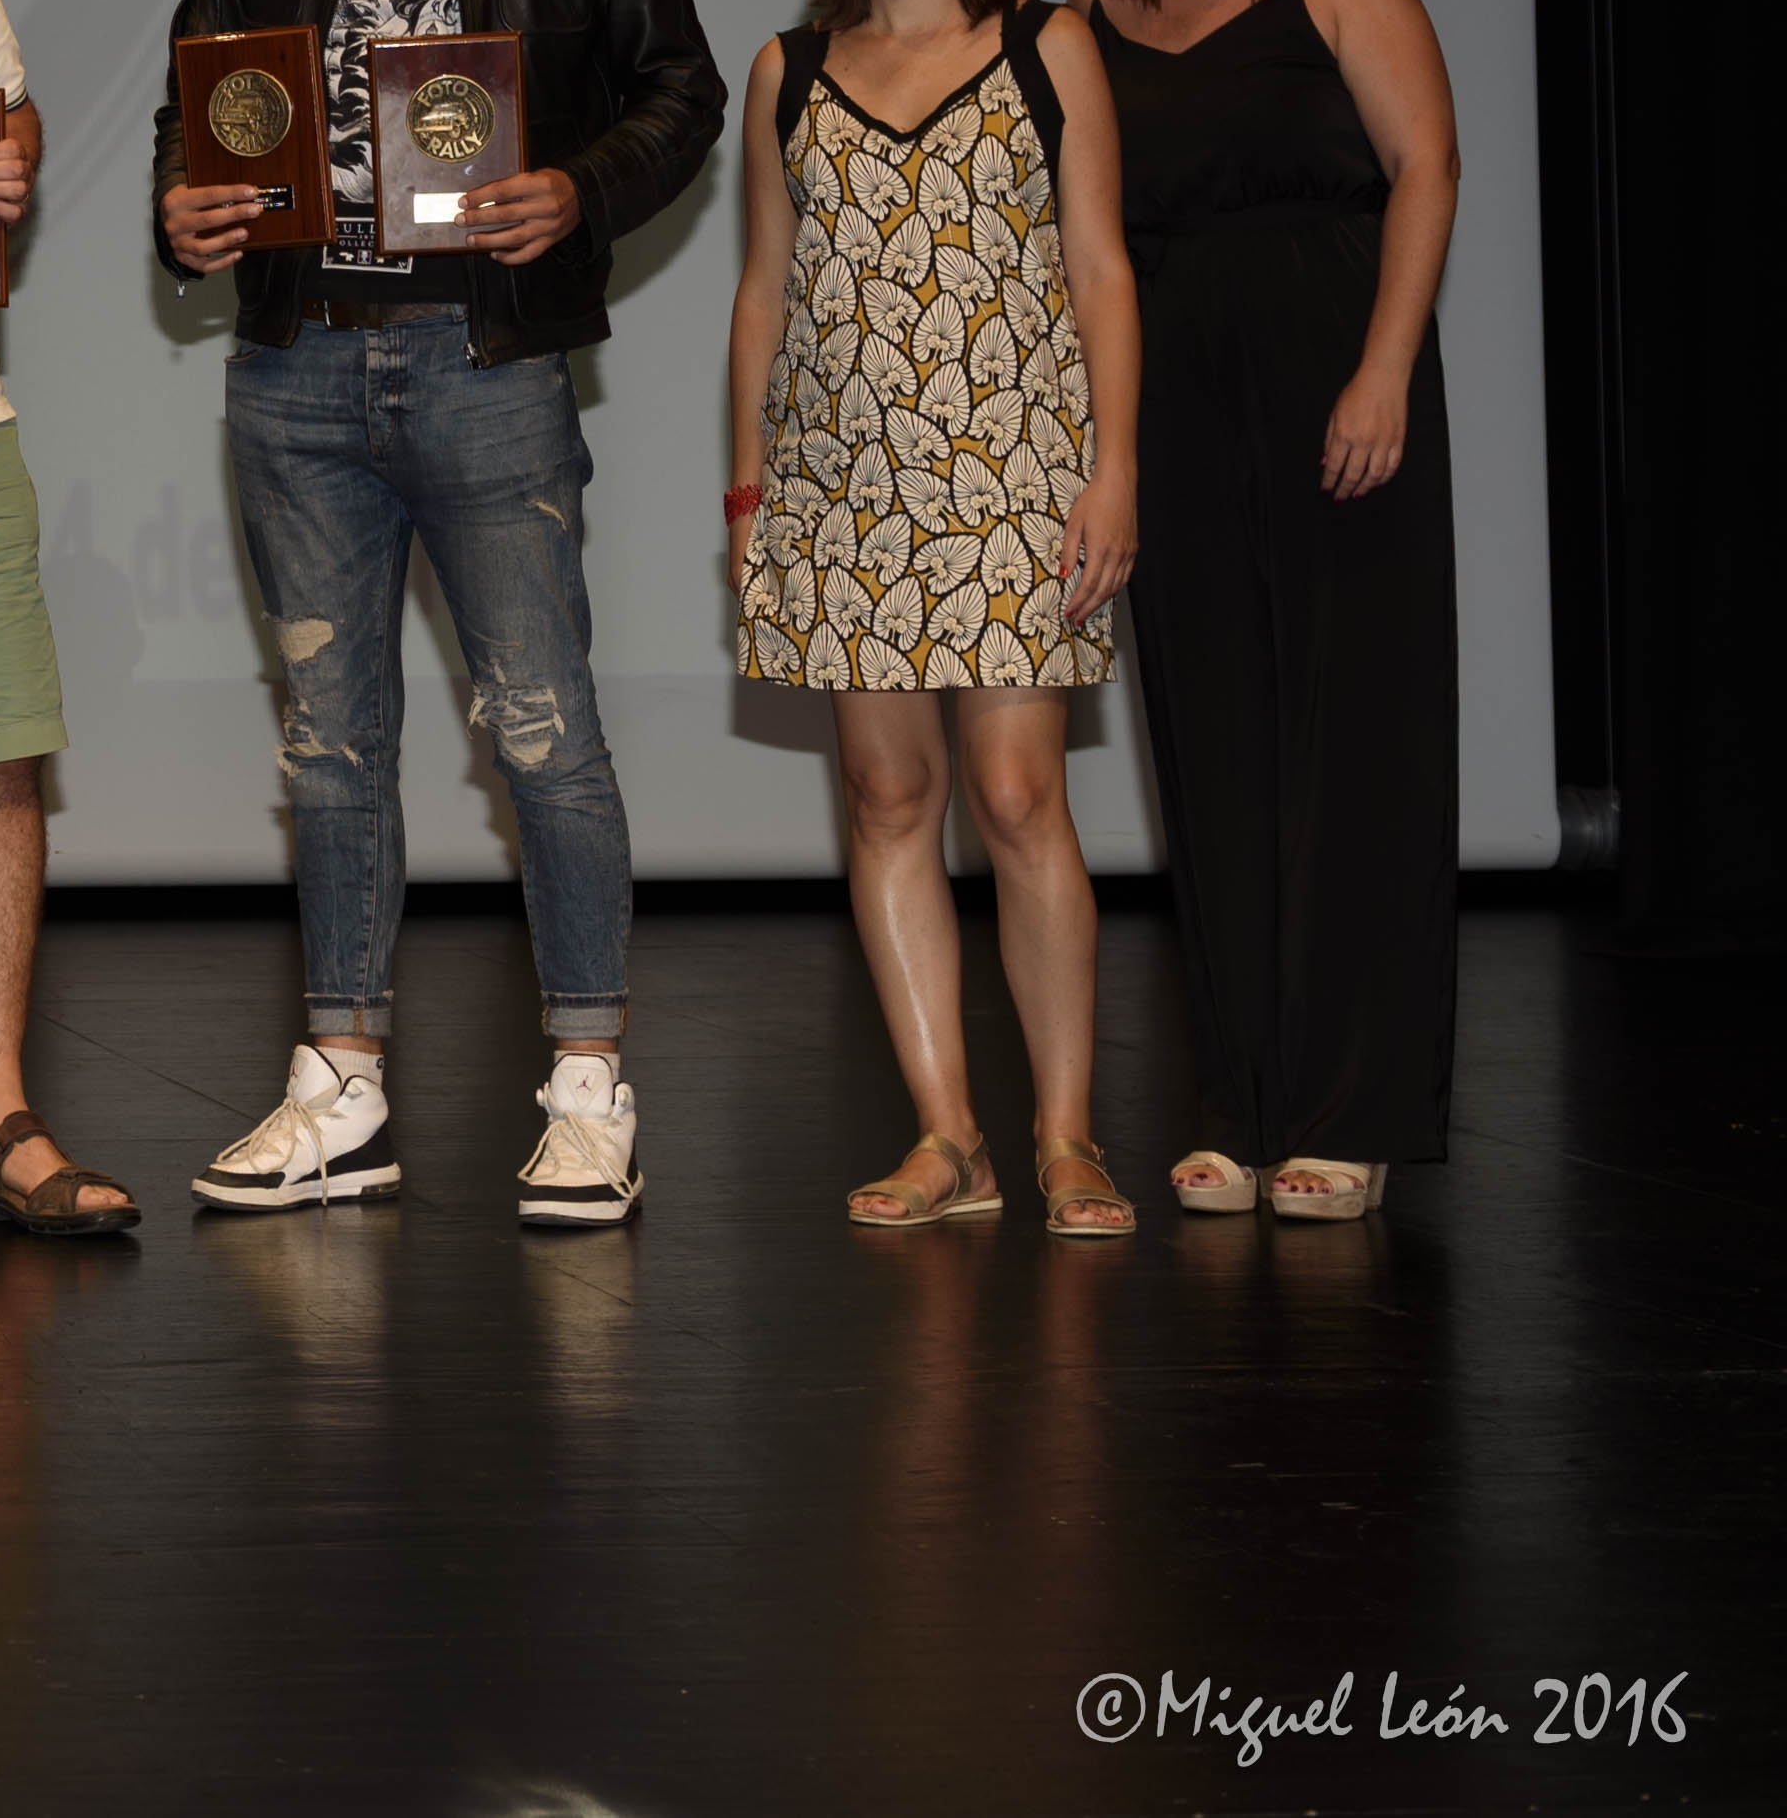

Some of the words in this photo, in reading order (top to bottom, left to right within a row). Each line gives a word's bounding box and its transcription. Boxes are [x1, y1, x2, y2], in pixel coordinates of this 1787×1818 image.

[417, 80, 469, 108] FOTO
[426, 130, 483, 159] RALLY
[335, 222, 377, 234] ULL
